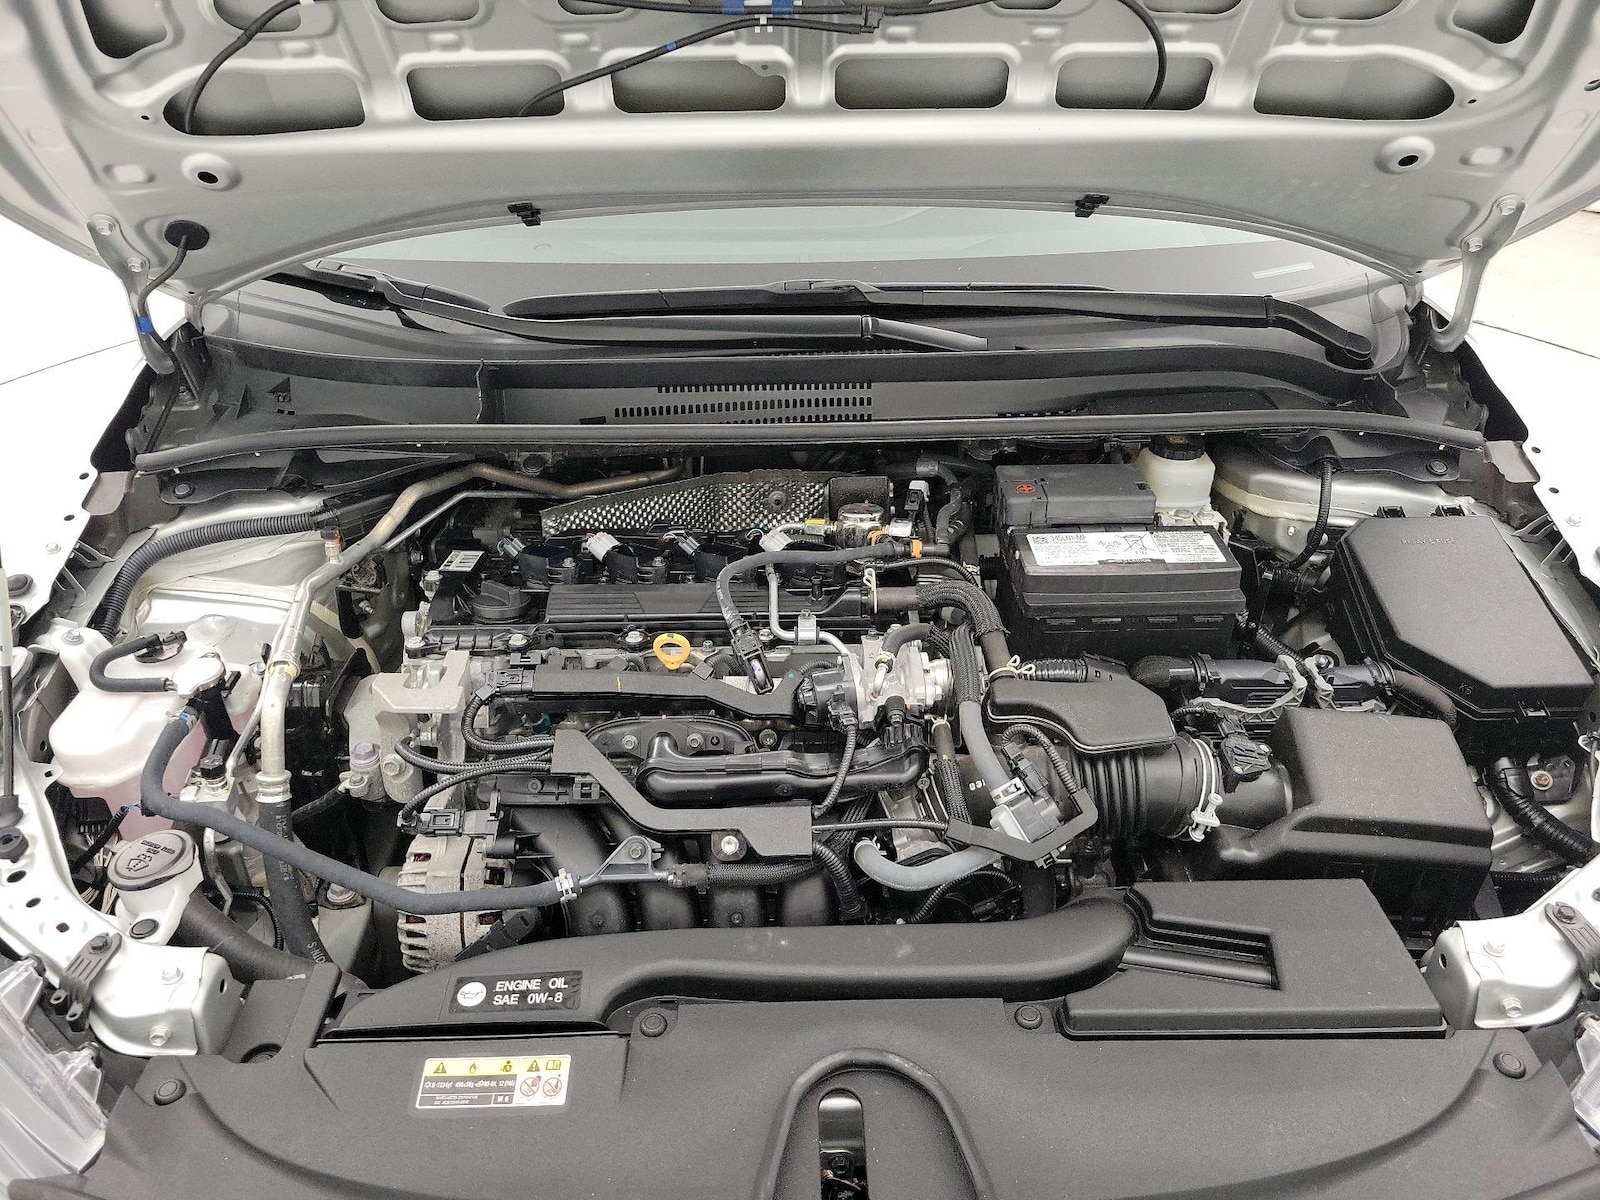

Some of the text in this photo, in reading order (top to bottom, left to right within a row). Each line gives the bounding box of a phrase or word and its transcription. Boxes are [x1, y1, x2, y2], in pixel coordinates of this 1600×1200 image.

[495, 976, 569, 992] ENGINE OIL
[492, 991, 563, 1006] SAE 0W-8
